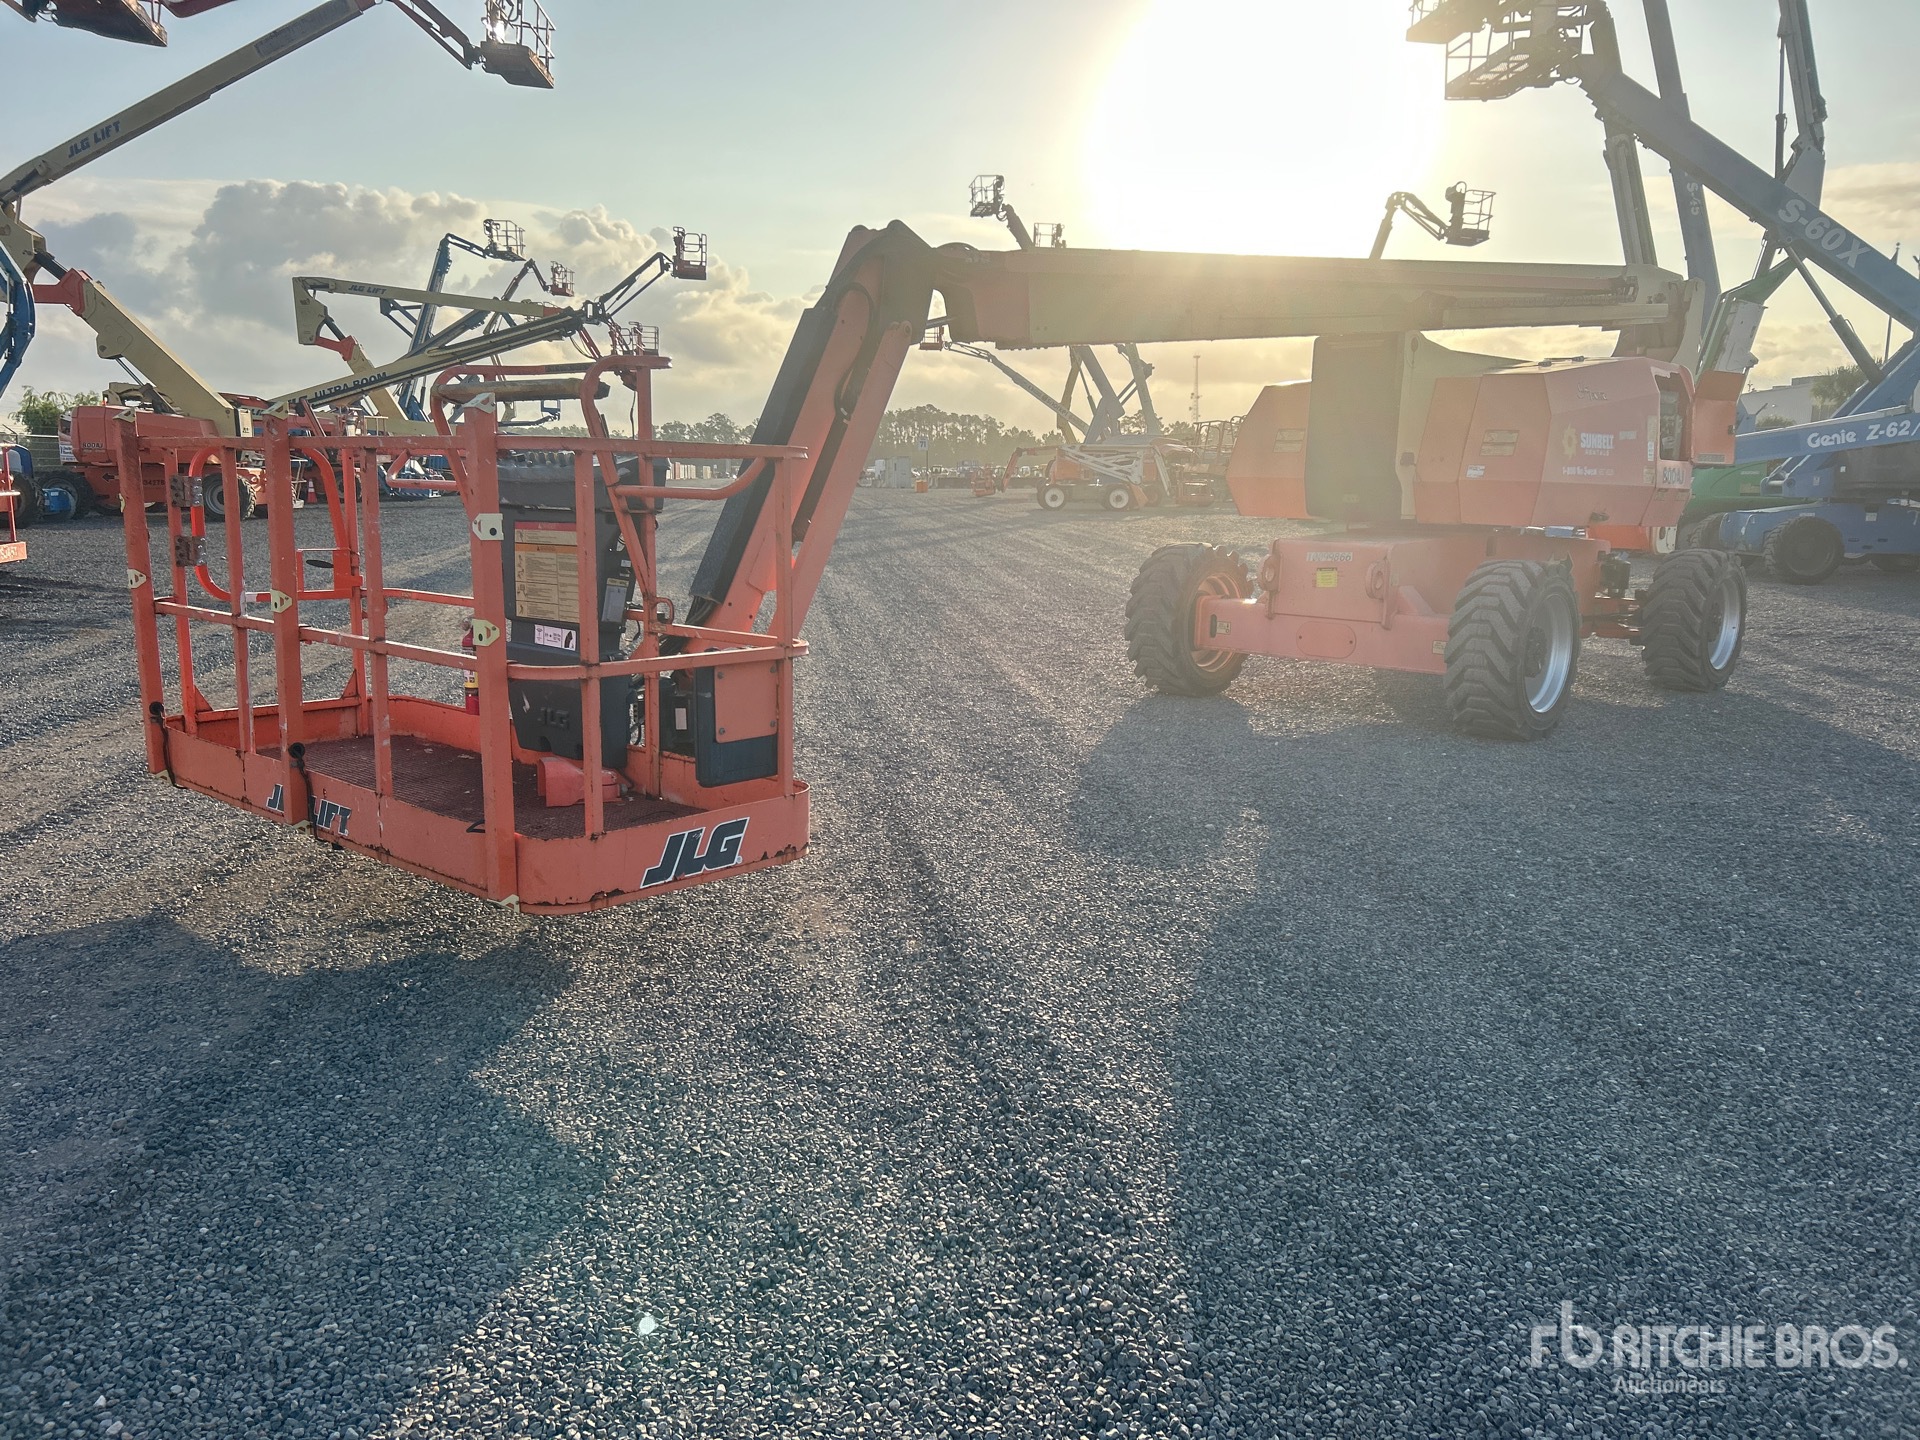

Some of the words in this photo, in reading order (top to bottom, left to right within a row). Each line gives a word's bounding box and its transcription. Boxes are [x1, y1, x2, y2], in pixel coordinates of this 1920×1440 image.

[68, 136, 90, 158] JLG
[93, 120, 120, 144] LIFT
[1778, 199, 1871, 269] S-60X
[348, 284, 365, 292] JLG
[366, 286, 387, 295] LIFT
[314, 384, 348, 398] ULTRA
[353, 371, 387, 389] BOOM
[1581, 433, 1614, 449] SUNBELT
[1807, 429, 1857, 448] Genie
[640, 817, 750, 888] JLG
